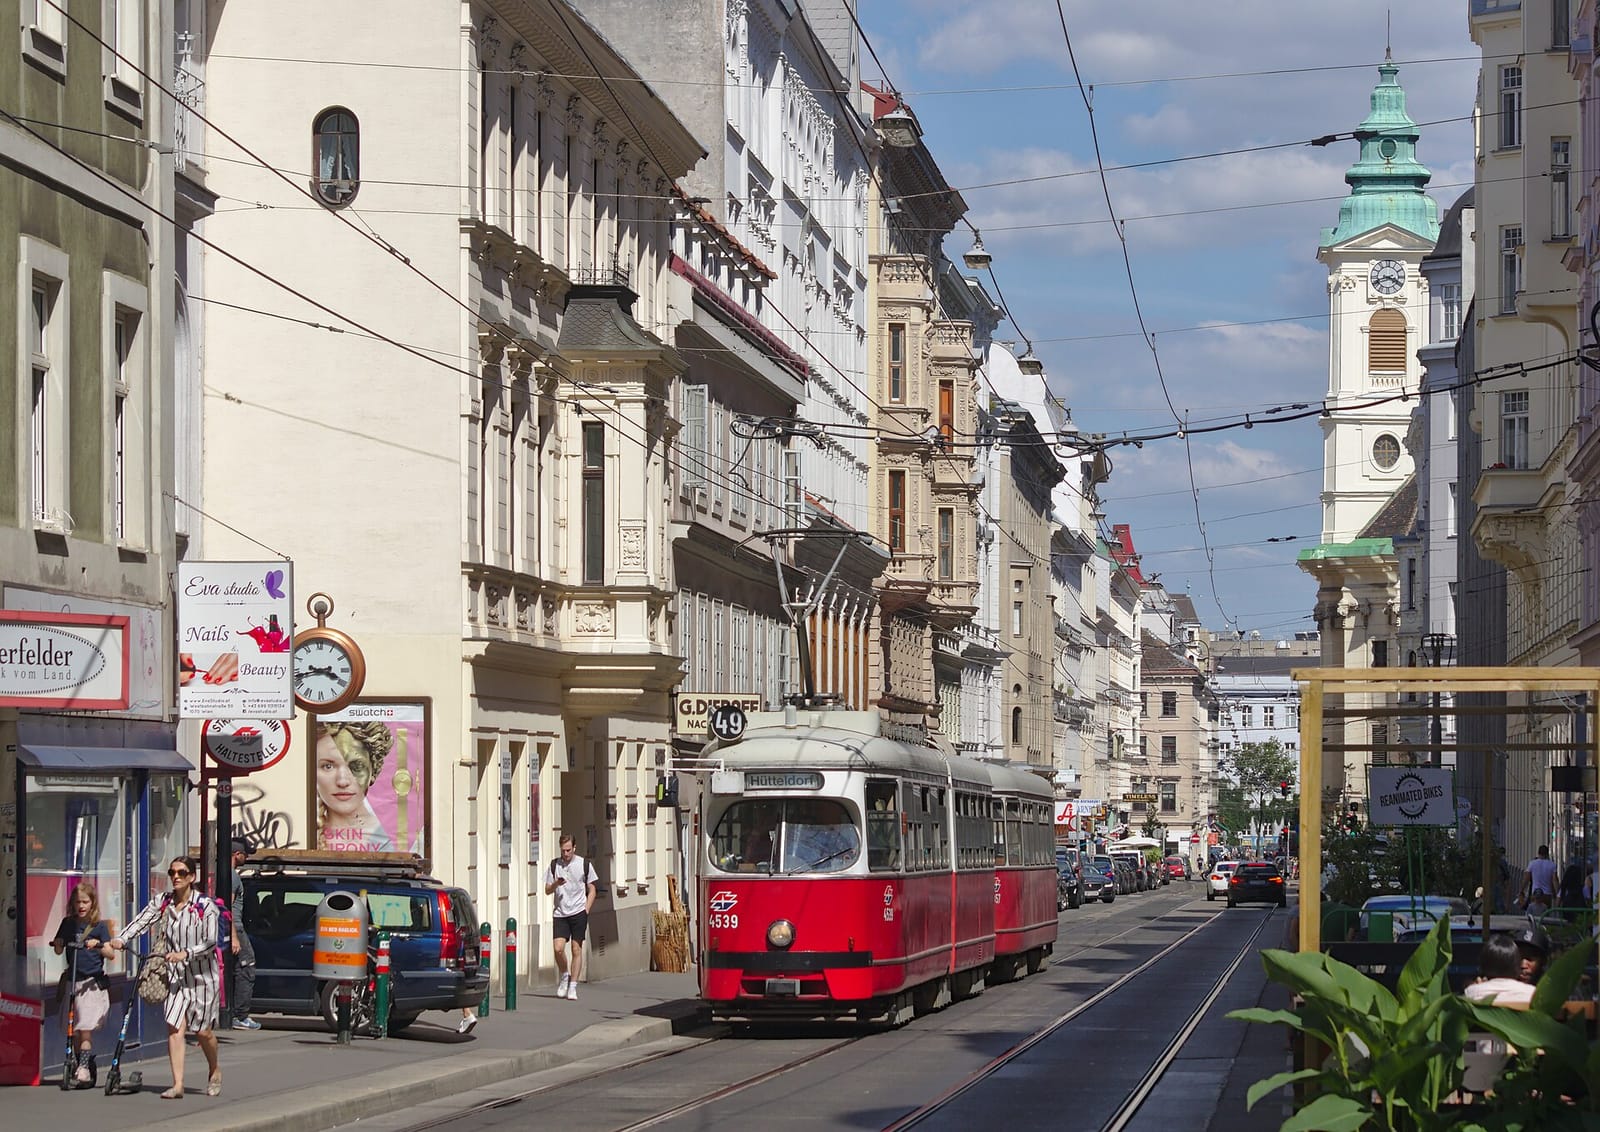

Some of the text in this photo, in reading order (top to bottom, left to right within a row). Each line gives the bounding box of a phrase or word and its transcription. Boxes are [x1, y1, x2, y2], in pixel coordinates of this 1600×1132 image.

[185, 576, 260, 597] Eva studio
[185, 624, 230, 642] Nails
[14, 669, 36, 679] vom
[44, 668, 76, 681] Land.
[240, 663, 287, 679] Beauty
[348, 708, 386, 717] swatch
[687, 719, 707, 729] NAC
[715, 711, 743, 735] 49
[215, 743, 278, 764] HALTESTELLE
[750, 775, 814, 786] Hütteldorf
[218, 784, 232, 794] 49
[1380, 785, 1443, 807] REANIMATED BIKES
[323, 828, 363, 840] SKIN
[328, 843, 381, 852] IRONY
[709, 914, 738, 929] 4539
